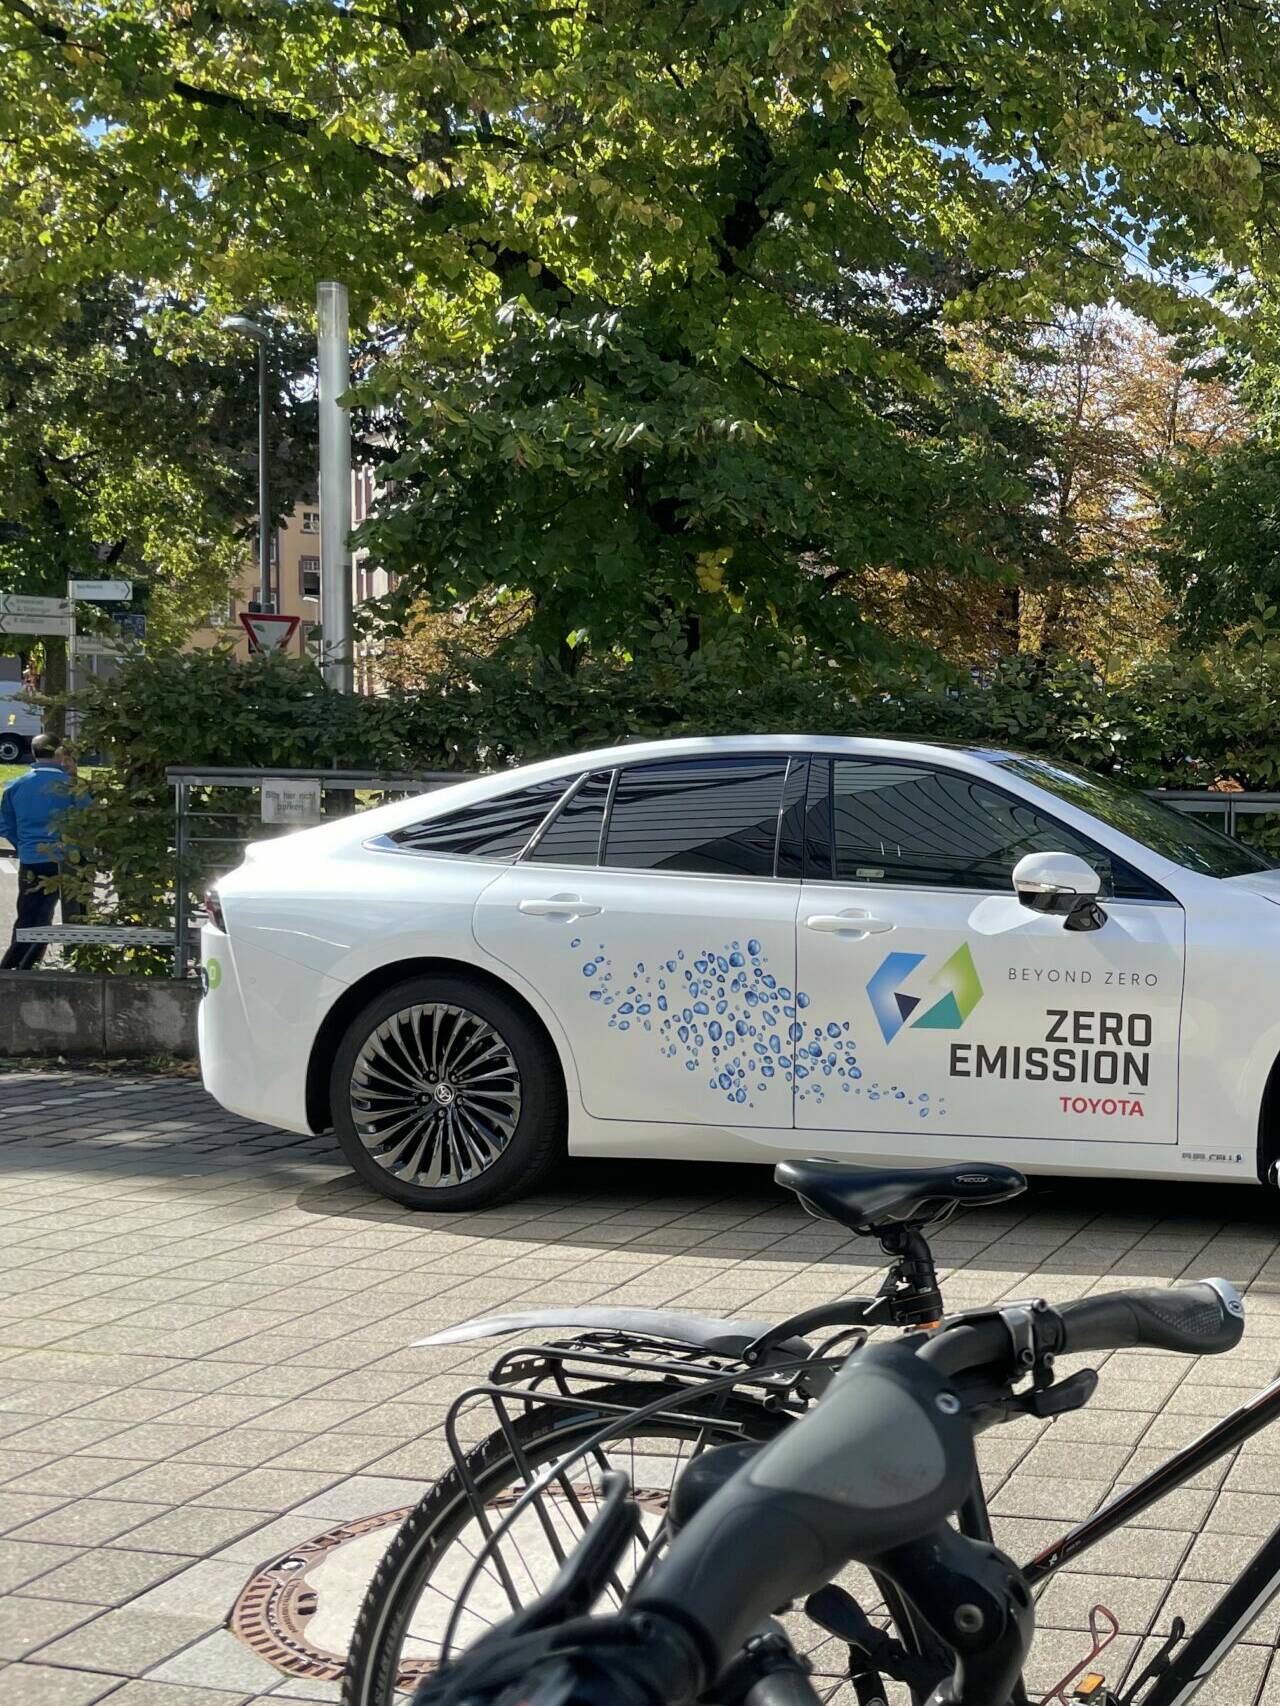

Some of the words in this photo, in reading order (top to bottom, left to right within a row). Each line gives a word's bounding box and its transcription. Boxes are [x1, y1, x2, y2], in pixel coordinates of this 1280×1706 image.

[1008, 967, 1093, 984] BEYOND
[1104, 971, 1159, 987] ZERO
[1045, 1009, 1152, 1047] ZERO
[949, 1043, 1150, 1087] EMISSION
[1059, 1096, 1144, 1117] TOYOTA
